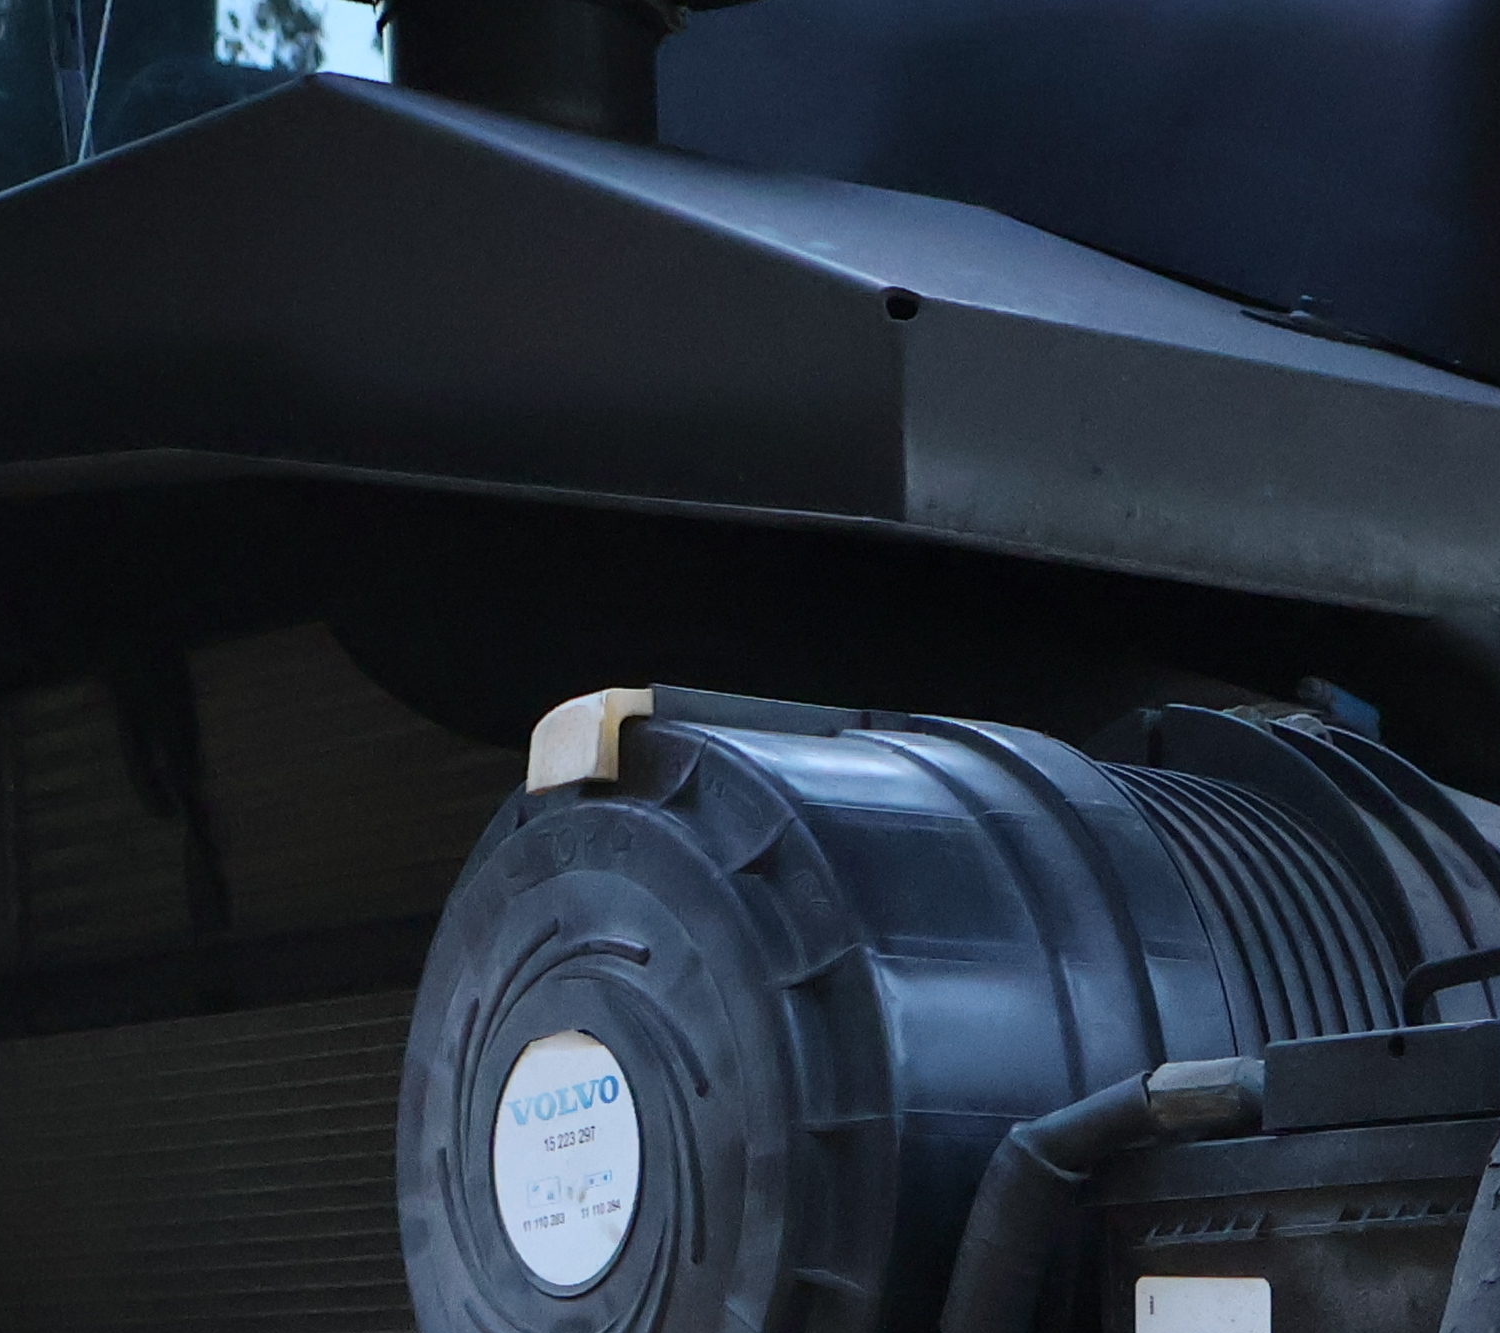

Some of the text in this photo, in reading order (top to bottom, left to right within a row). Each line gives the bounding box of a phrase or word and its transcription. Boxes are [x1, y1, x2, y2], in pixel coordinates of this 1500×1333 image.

[506, 1075, 619, 1126] VOLVO
[543, 1125, 596, 1152] 15 223 297
[592, 1202, 605, 1217] 110
[522, 1220, 532, 1233] 11
[534, 1215, 549, 1230] 110
